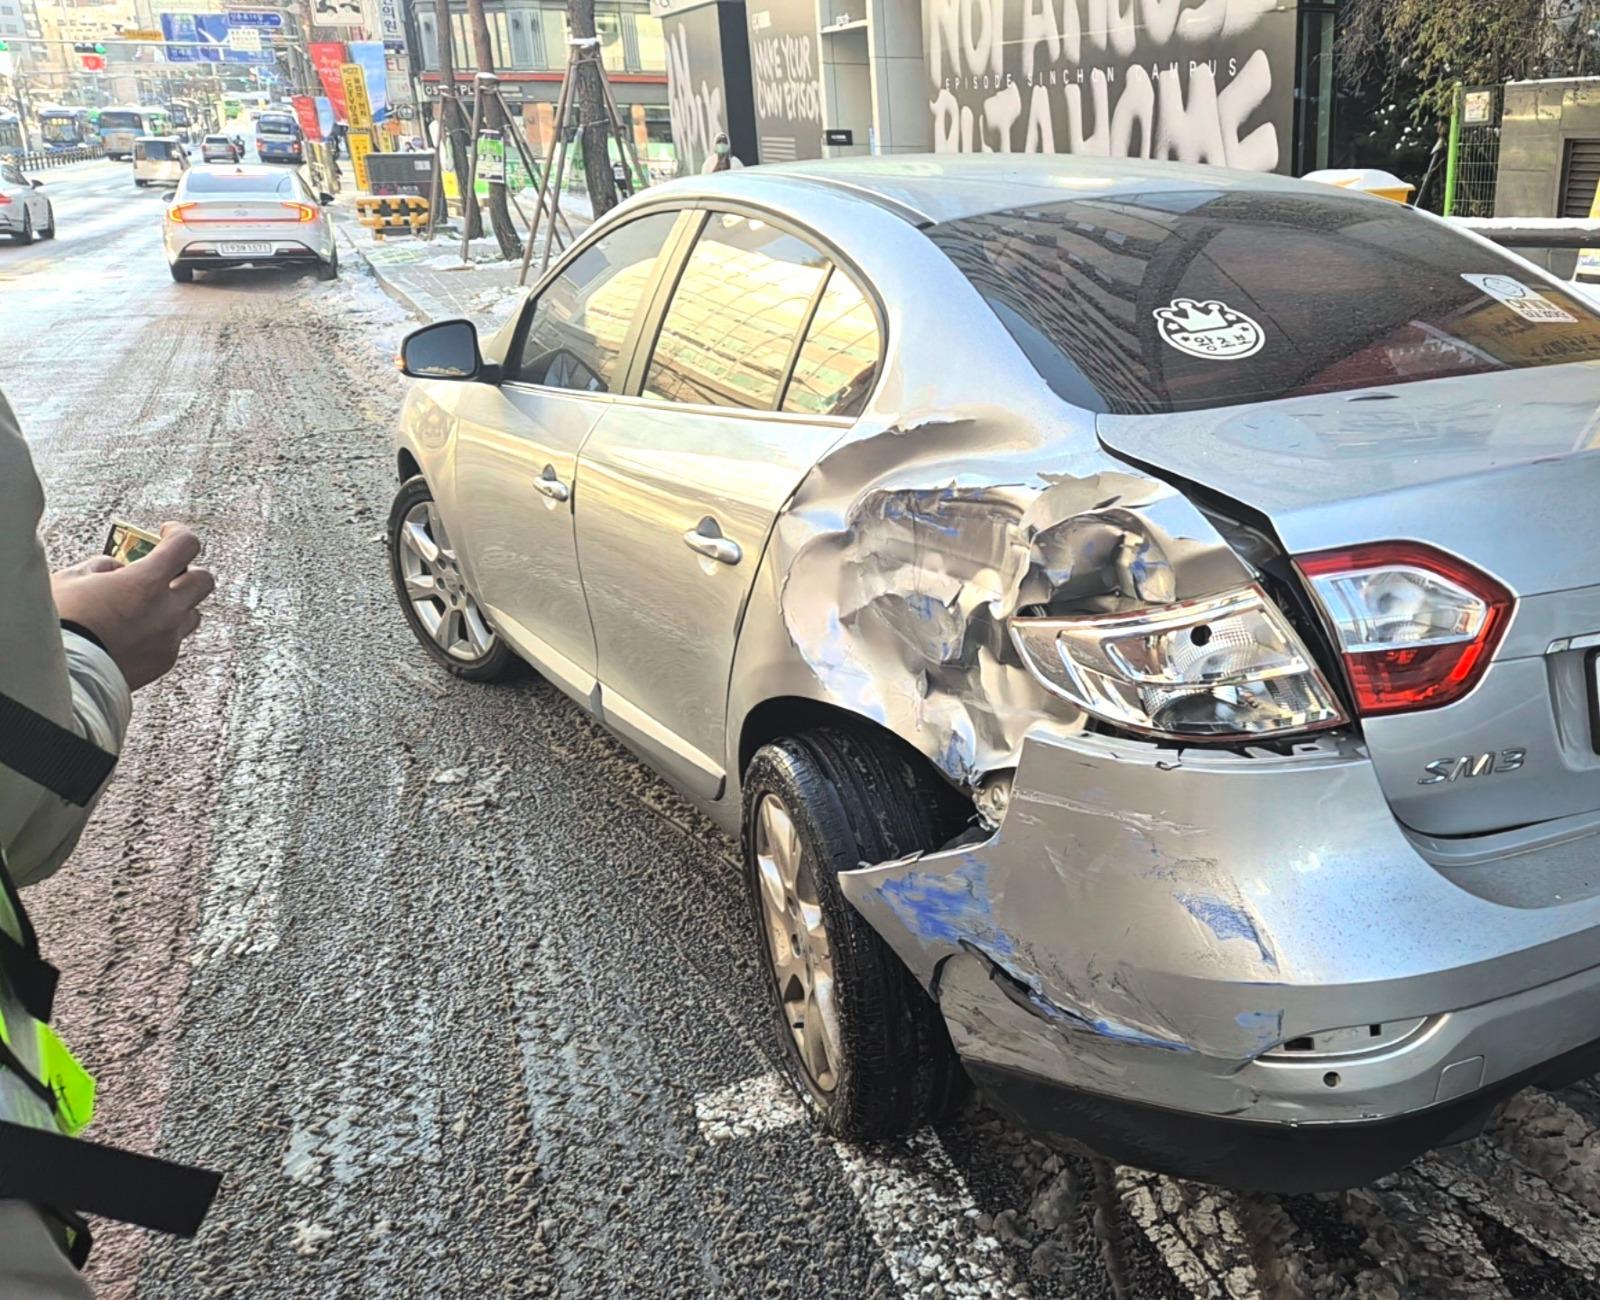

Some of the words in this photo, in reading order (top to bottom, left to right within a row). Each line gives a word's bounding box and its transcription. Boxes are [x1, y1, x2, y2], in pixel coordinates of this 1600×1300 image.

[780, 33, 812, 81] YOUR
[945, 73, 1013, 90] EPISODE
[1027, 66, 1115, 87] SINCHON
[1134, 57, 1237, 81] AMPUS
[757, 81, 782, 119] OWN
[1194, 333, 1253, 351] 왕초보
[1417, 747, 1527, 785] SM3
